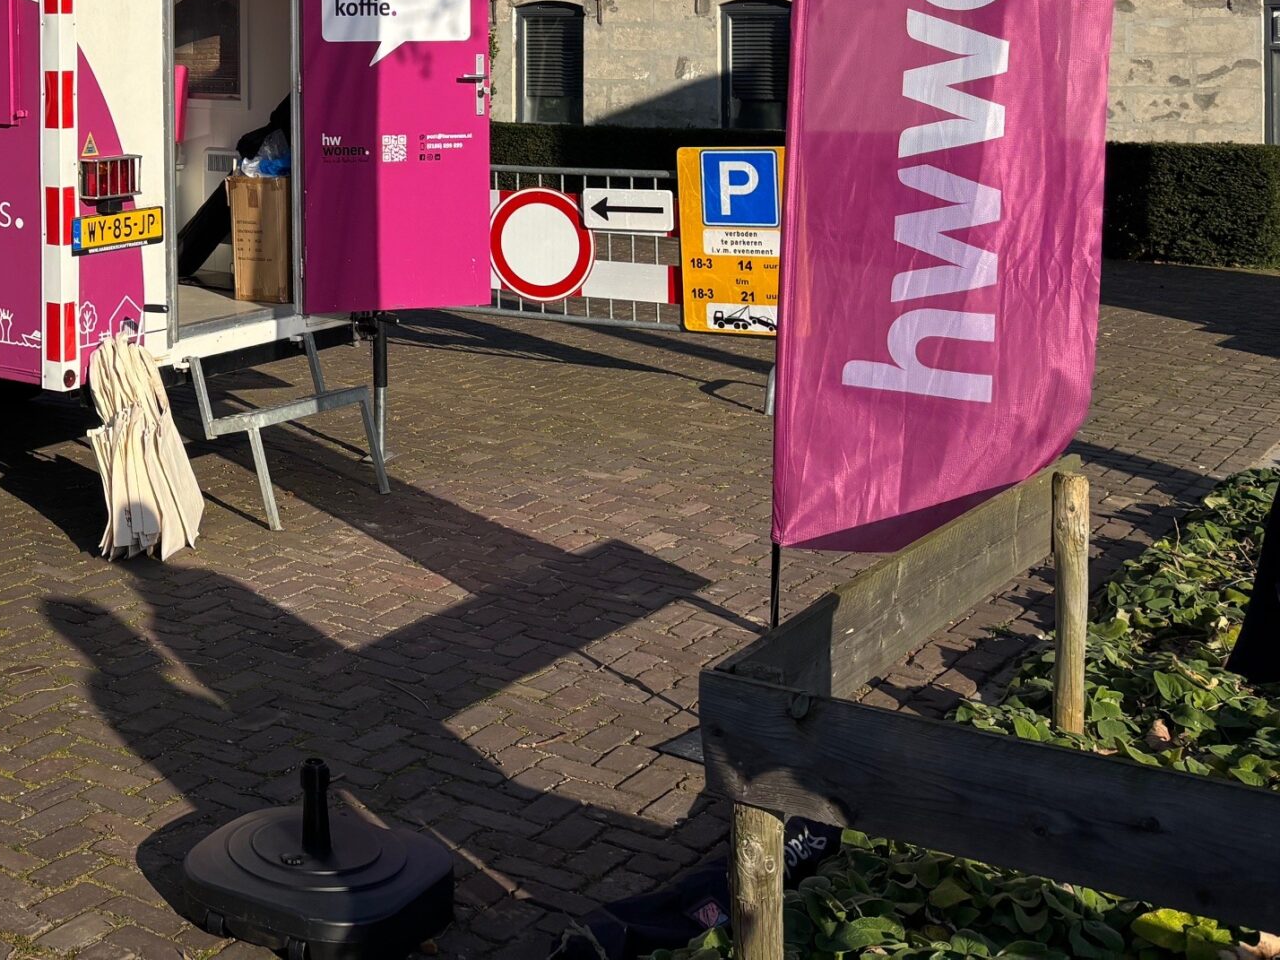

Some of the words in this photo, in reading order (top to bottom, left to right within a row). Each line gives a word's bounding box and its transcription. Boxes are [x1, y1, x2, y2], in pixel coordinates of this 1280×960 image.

[322, 133, 341, 146] hw
[719, 161, 759, 215] P
[87, 213, 156, 243] WY-85-JP
[730, 239, 763, 247] parkeren
[690, 258, 713, 269] 18-3
[737, 260, 753, 271] 14
[735, 278, 749, 286] t/m
[691, 288, 714, 299] 18-3
[740, 291, 755, 302] 21
